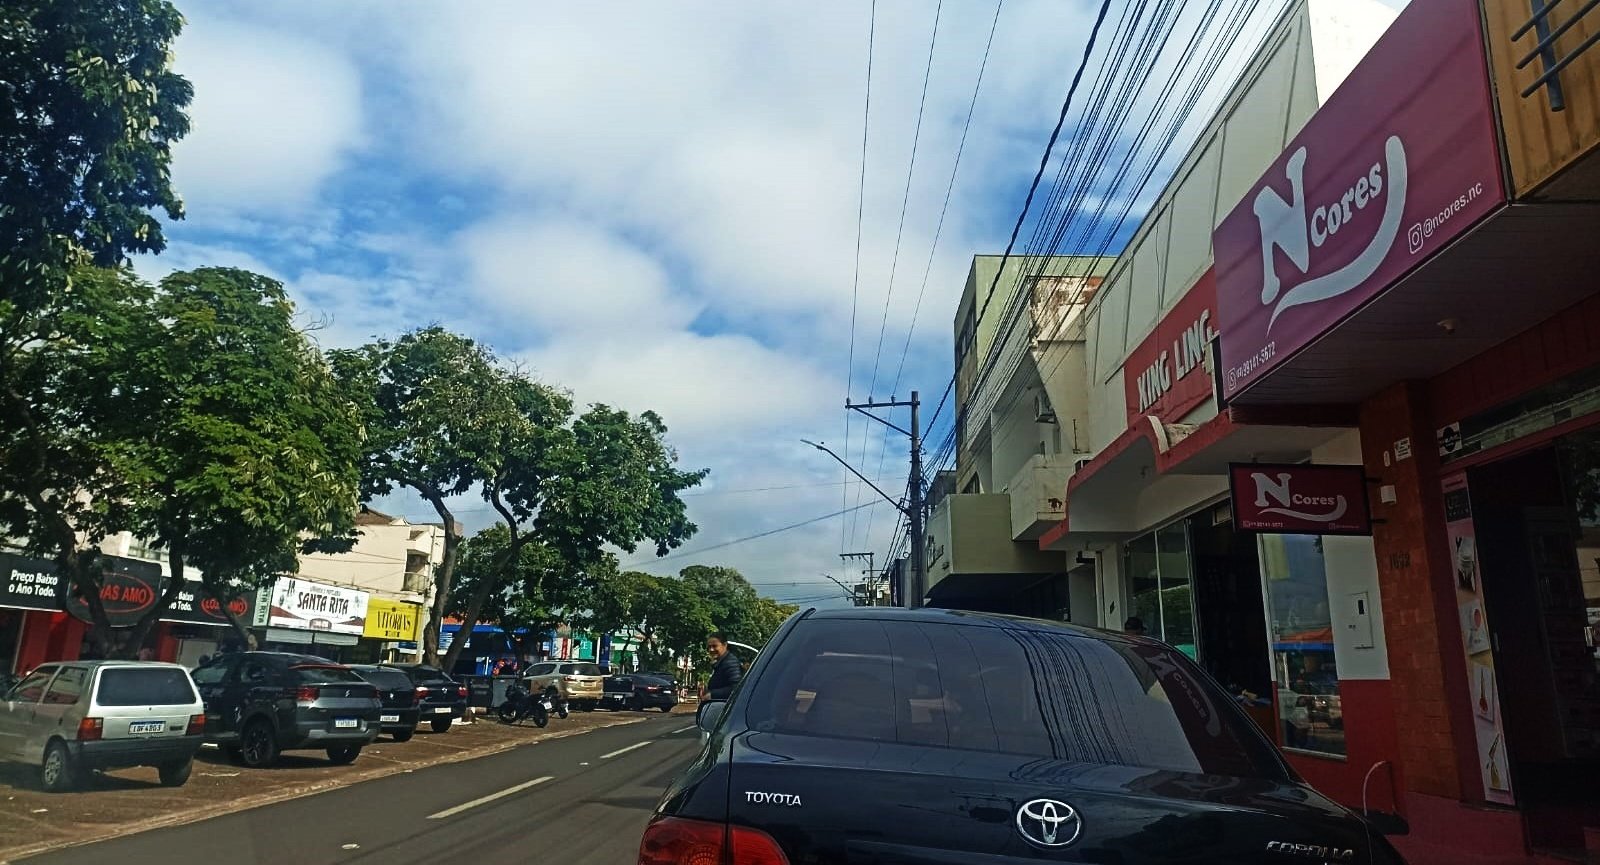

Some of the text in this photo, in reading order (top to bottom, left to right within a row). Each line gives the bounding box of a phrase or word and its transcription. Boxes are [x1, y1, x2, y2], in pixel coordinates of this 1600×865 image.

[1422, 182, 1483, 238] @ncores.nc
[1253, 146, 1309, 305] N
[1251, 472, 1335, 507] N Cores
[10, 568, 59, 586] Preço Baixo
[8, 583, 56, 598] o Ano Todo.
[121, 586, 148, 604] AMO
[297, 591, 328, 613] SANTA
[329, 597, 349, 616] RITA
[745, 791, 802, 807] TOYOTA
